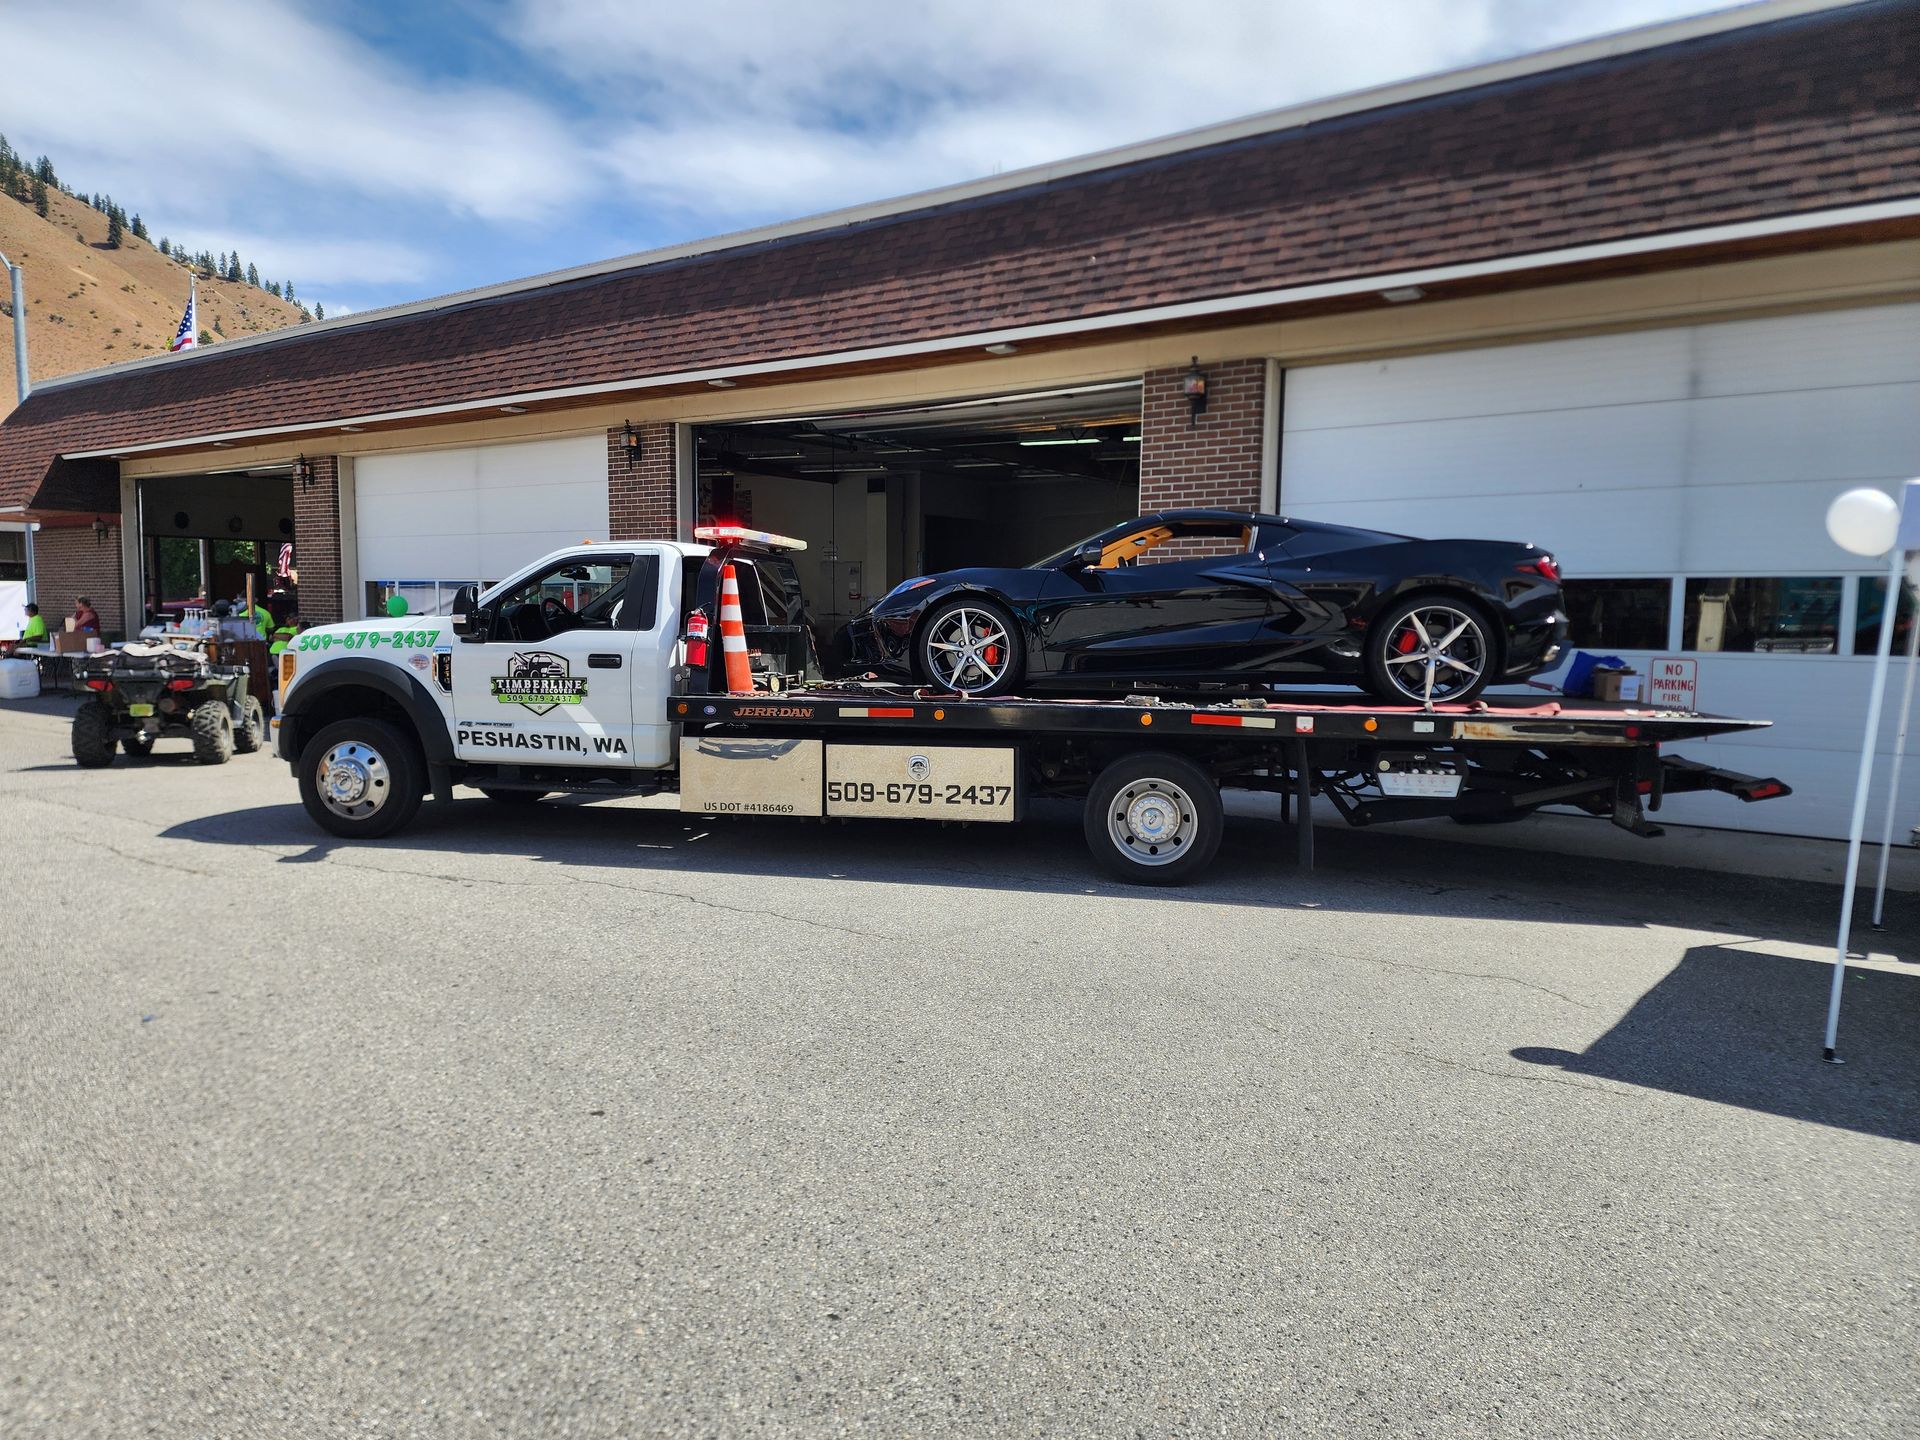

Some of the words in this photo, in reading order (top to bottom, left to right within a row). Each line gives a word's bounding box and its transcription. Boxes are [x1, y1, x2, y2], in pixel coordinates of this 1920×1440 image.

[298, 630, 440, 651] 509-679-2437
[1665, 664, 1683, 676] NO
[496, 680, 582, 689] TIMBERLINE
[1653, 679, 1694, 691] PARKING
[1662, 693, 1681, 702] FIRE
[457, 730, 588, 756] PESHASTIN,
[593, 737, 628, 753] WA
[827, 781, 1012, 806] 509-679-2437
[703, 802, 718, 811] US
[719, 802, 742, 812] DOT
[743, 803, 794, 813] #4186469
